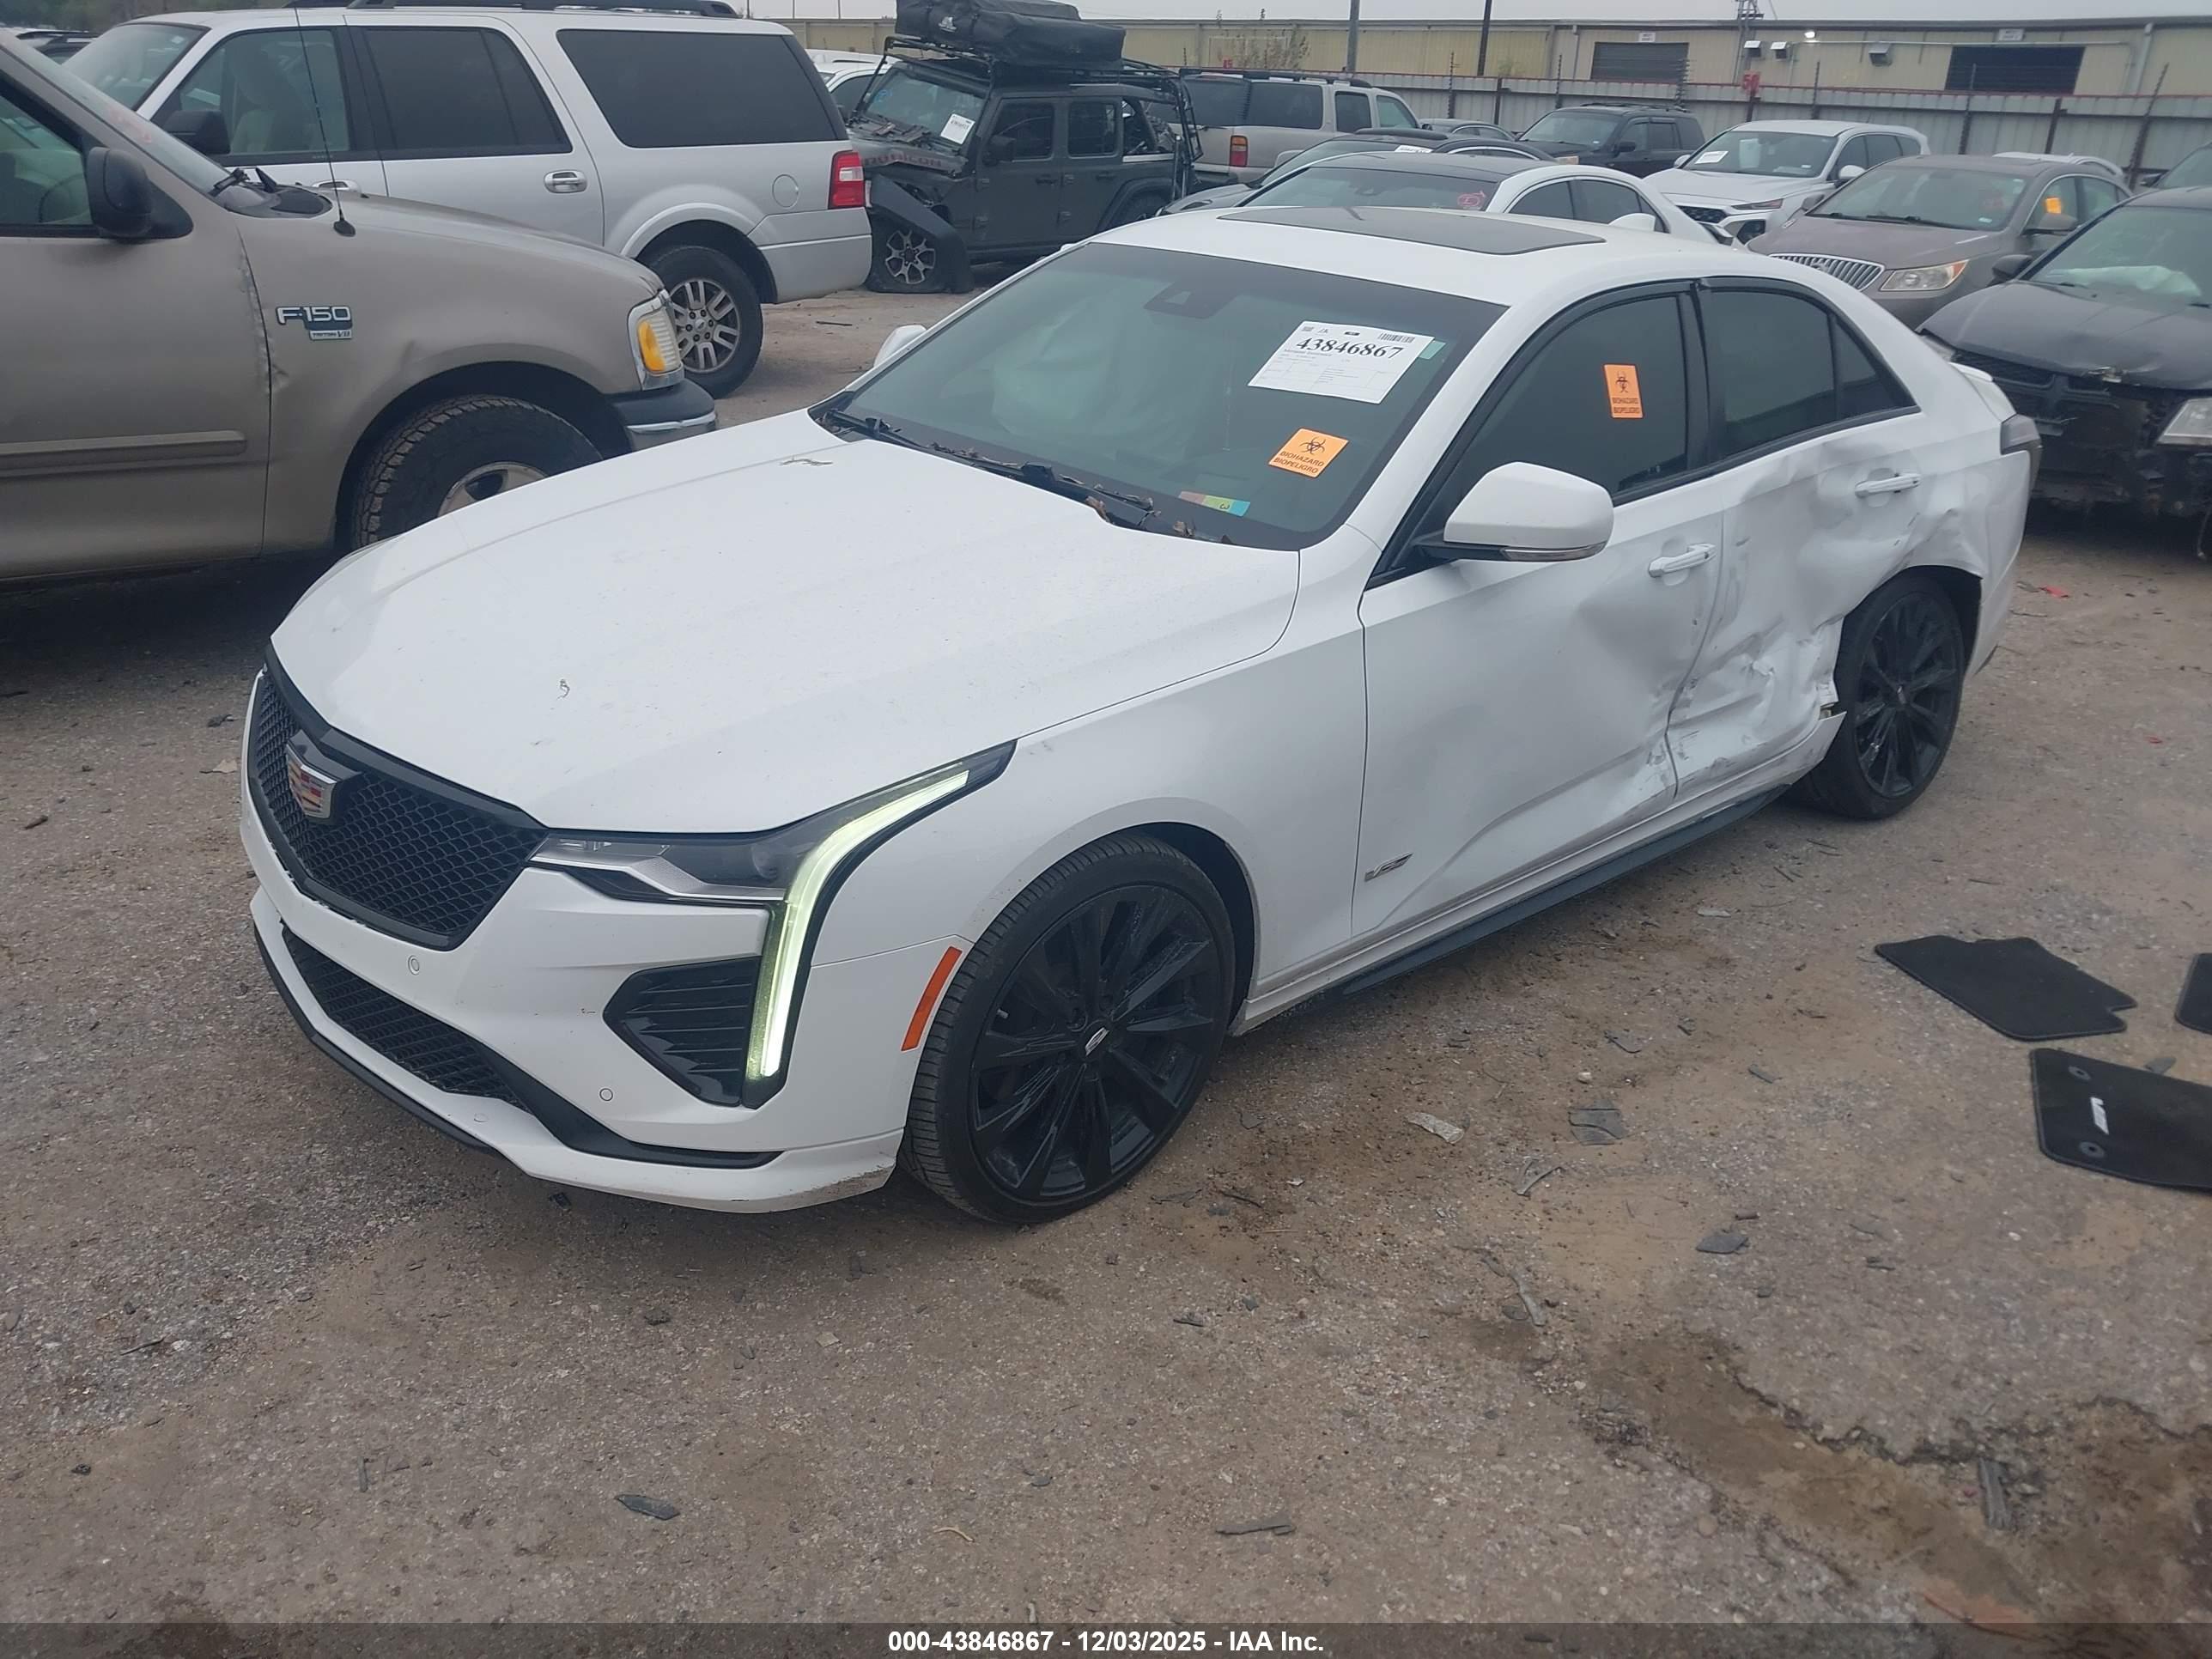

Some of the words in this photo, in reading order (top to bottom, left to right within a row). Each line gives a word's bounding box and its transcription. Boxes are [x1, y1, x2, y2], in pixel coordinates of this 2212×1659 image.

[1296, 337, 1405, 359] 43846867
[1273, 457, 1320, 474] BIOPELIGRO
[1279, 451, 1325, 467] BIOHAZARD
